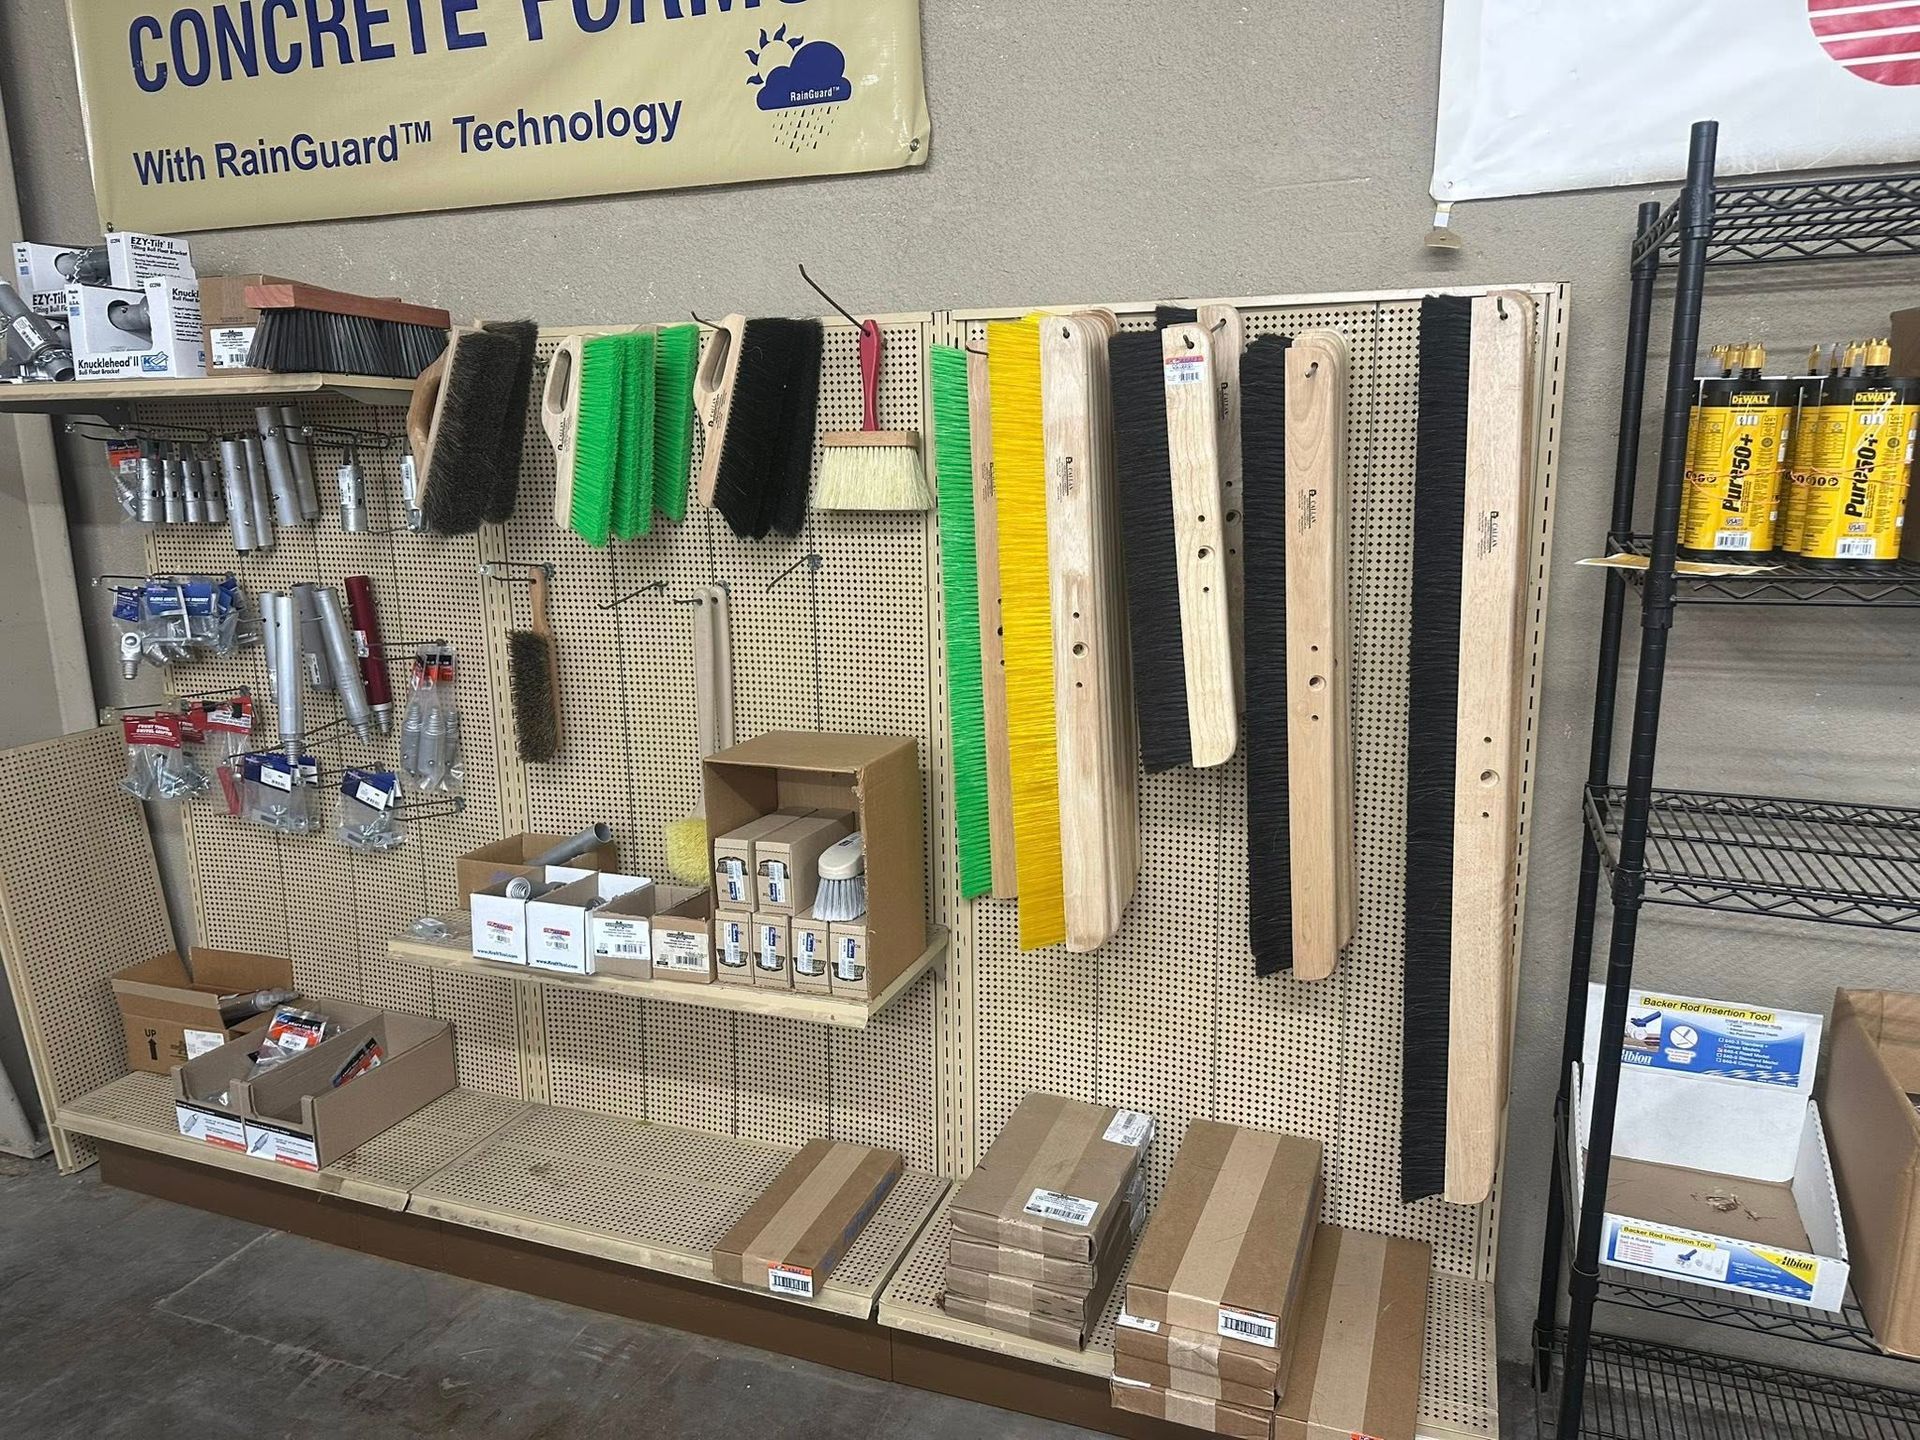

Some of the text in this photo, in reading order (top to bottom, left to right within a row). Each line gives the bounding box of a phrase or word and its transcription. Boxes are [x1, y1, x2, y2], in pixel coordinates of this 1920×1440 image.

[129, 0, 488, 93] CONCRETE
[133, 147, 206, 187] With
[453, 99, 683, 155] Technology
[78, 356, 130, 369] Knucklehead
[1722, 433, 1754, 514] Pure50+
[1844, 432, 1878, 519] Pure50+
[1643, 998, 1772, 1022] Backer Rod Insertion Tool
[144, 1028, 157, 1038] UP
[1623, 1226, 1712, 1249] Backer Rod Insertion Tool
[1782, 1255, 1813, 1271] Albion
